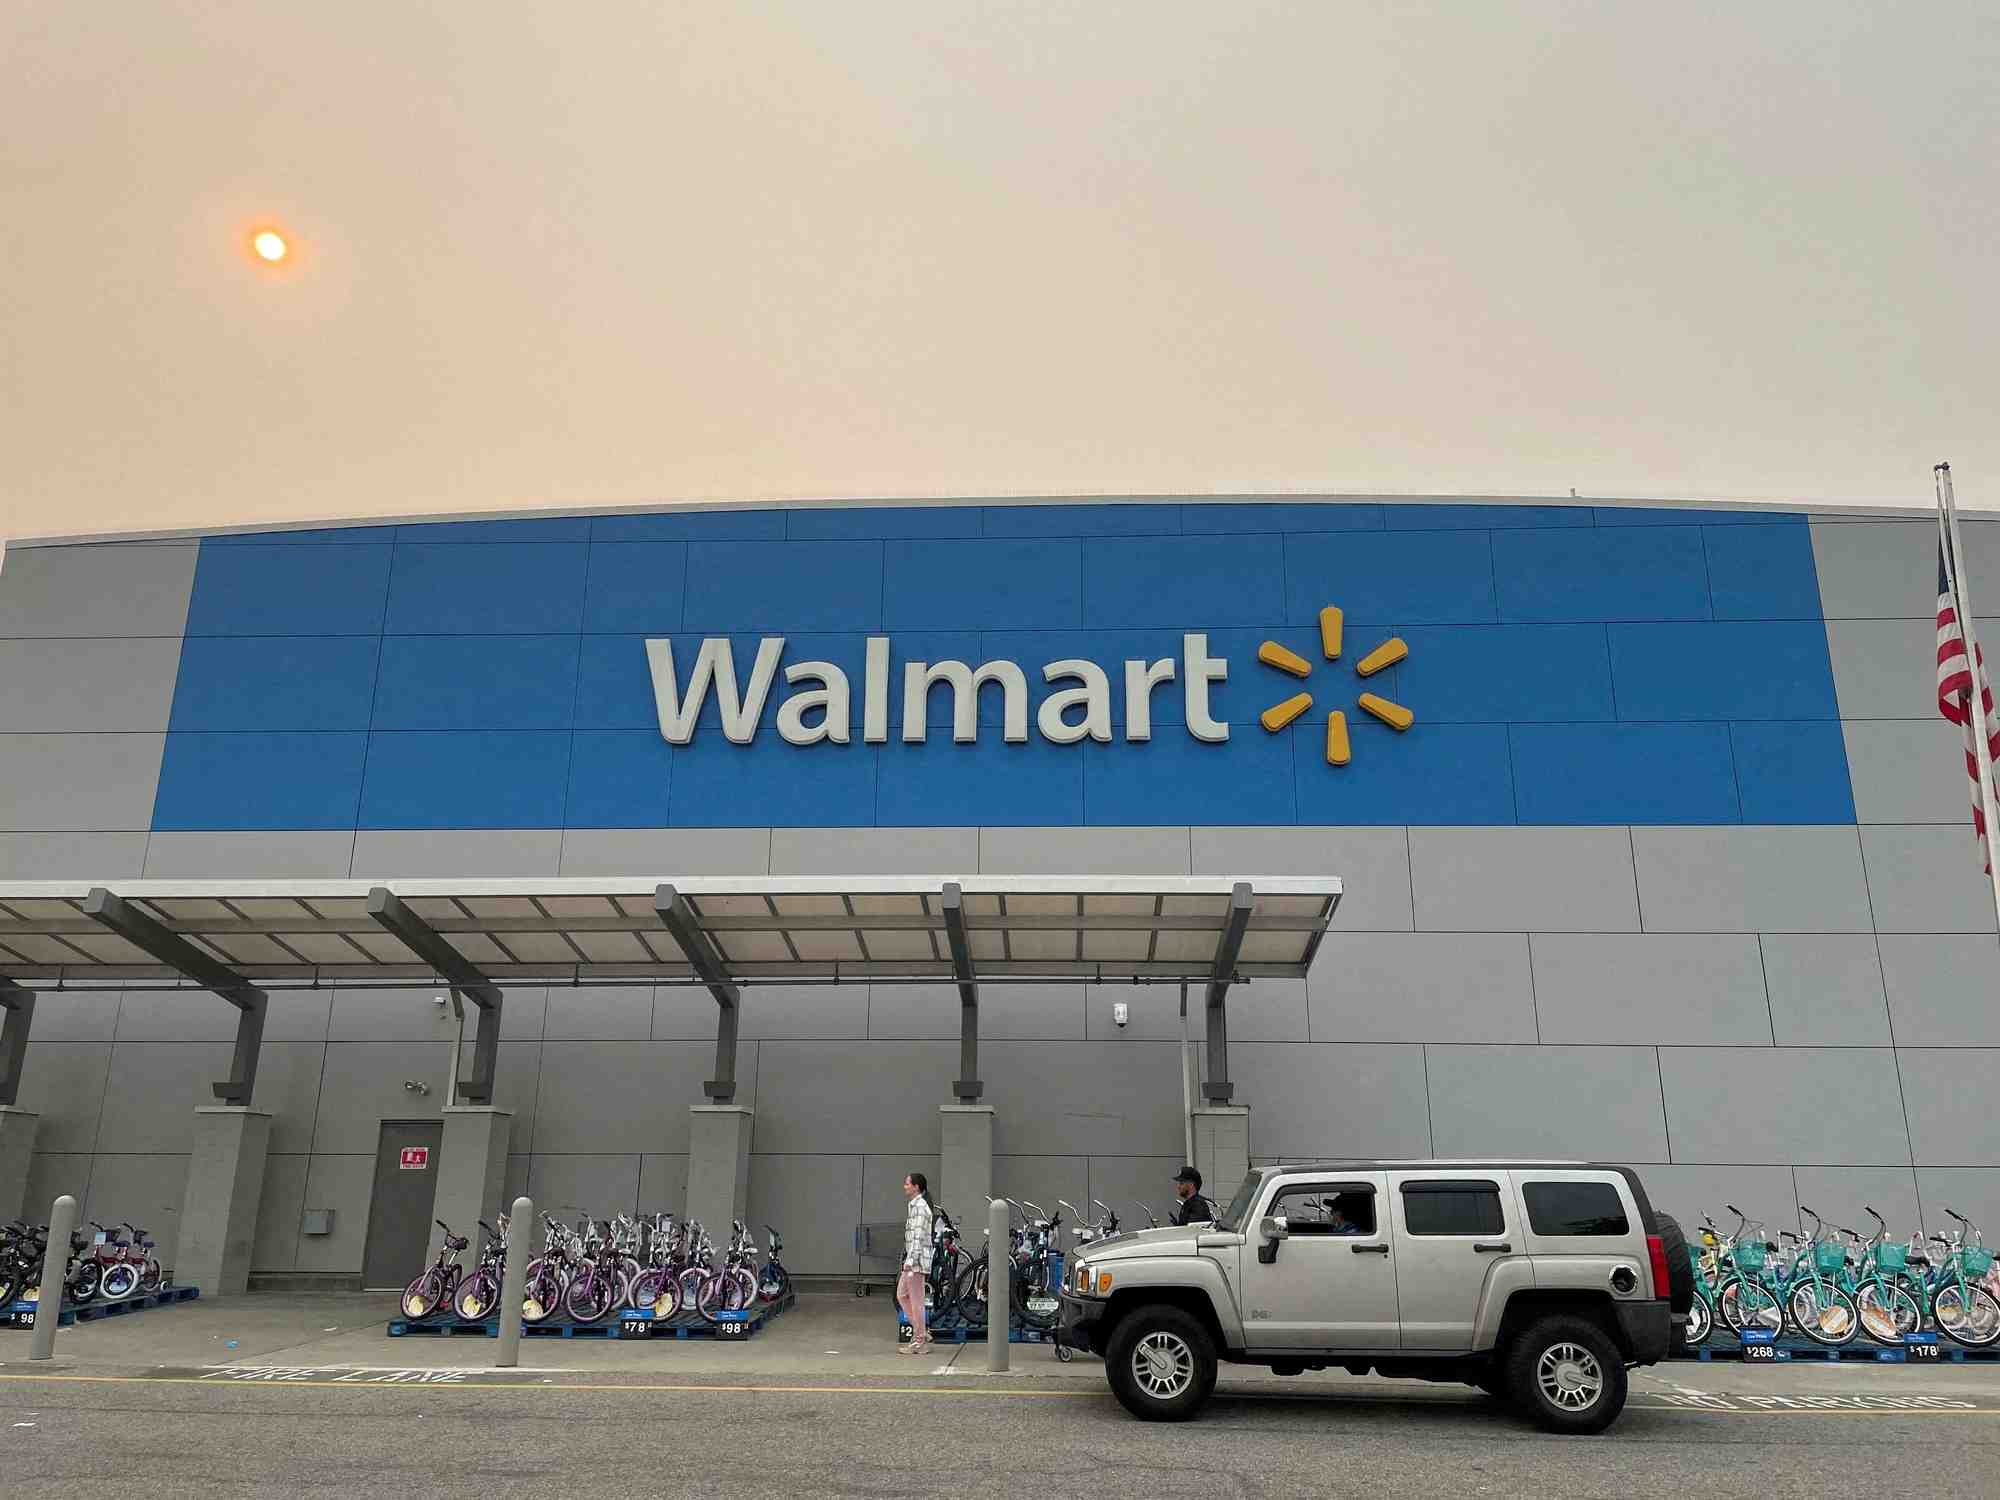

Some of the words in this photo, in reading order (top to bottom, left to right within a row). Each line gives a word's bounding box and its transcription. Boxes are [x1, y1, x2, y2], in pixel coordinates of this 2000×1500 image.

[644, 632, 1229, 745] Walmart
[1746, 1346, 1774, 1358] $268
[200, 1367, 336, 1381] FIRE
[333, 1370, 474, 1383] LANE
[1737, 1395, 1976, 1409] PARKING
